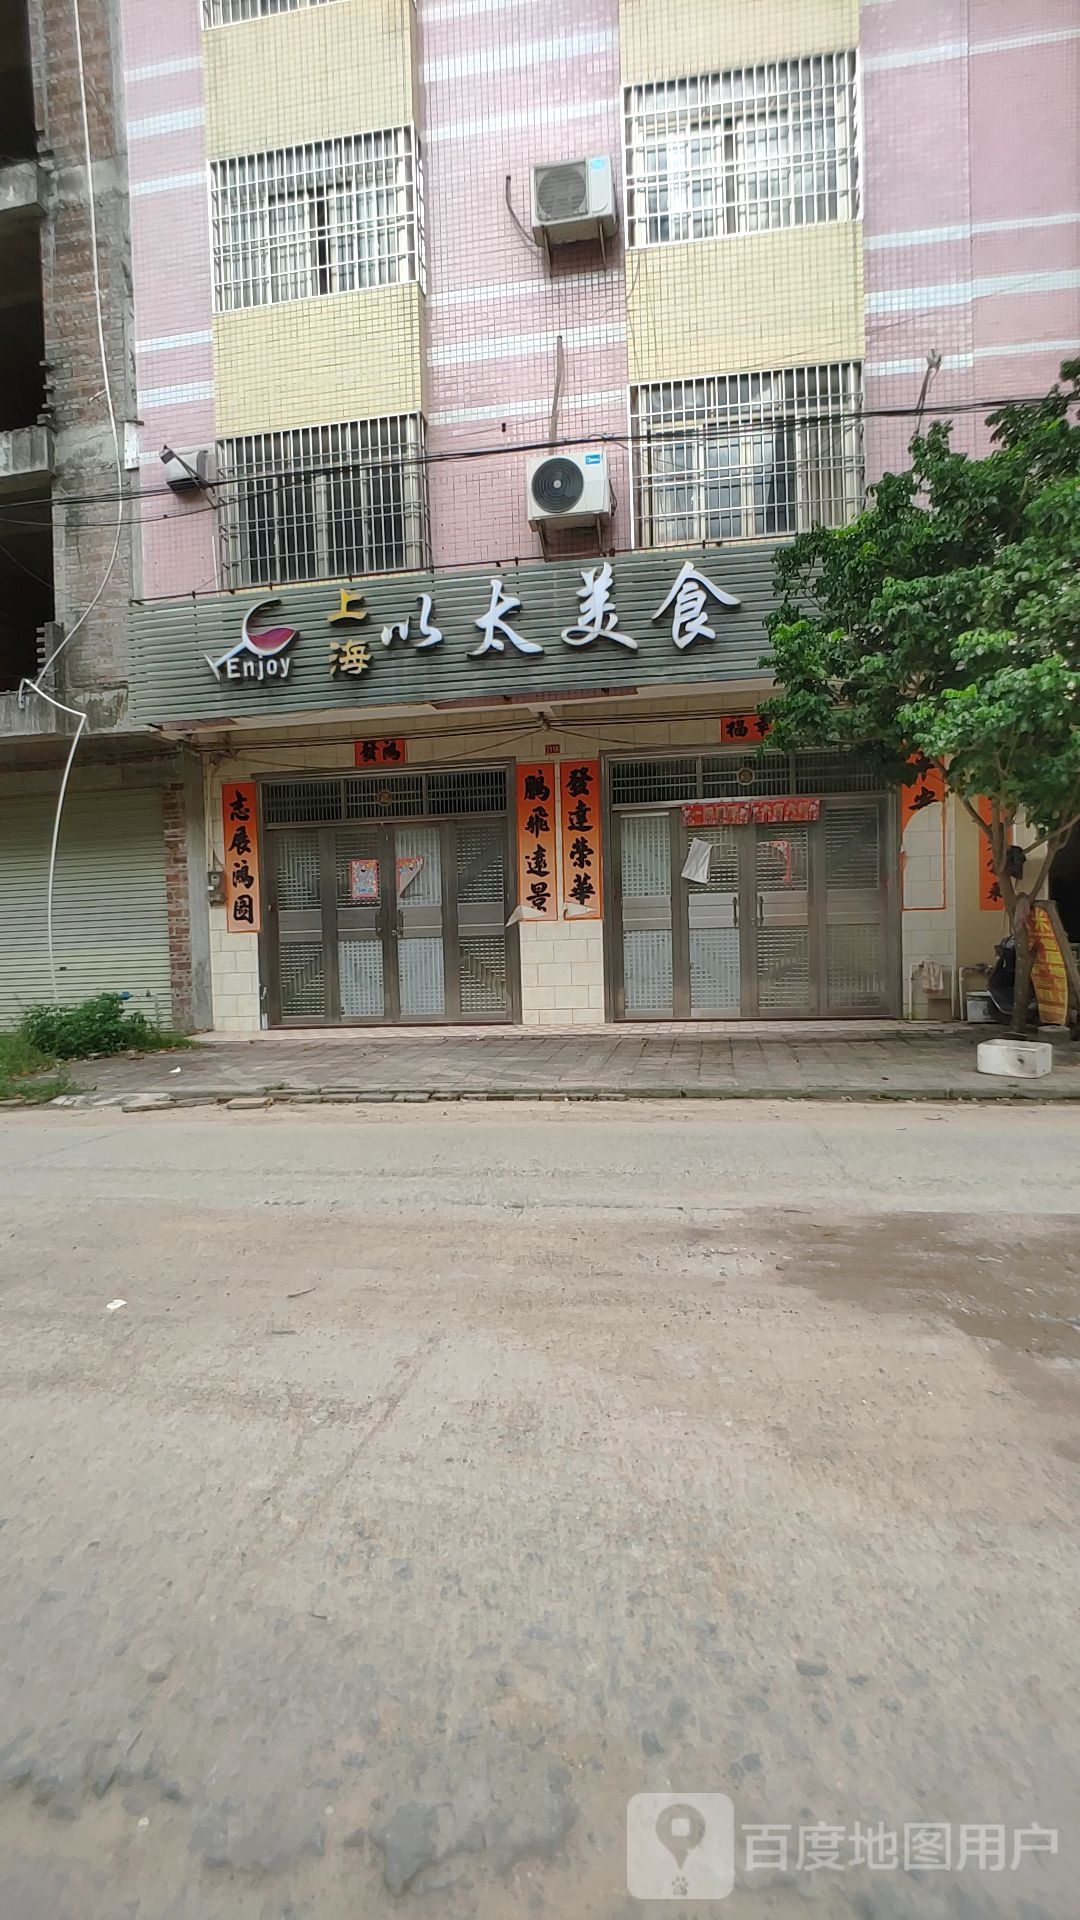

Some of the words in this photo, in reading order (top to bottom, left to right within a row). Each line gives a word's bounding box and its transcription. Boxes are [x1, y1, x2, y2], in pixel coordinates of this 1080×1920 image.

[327, 588, 373, 676] 上海
[381, 560, 741, 657] 以太美食
[227, 654, 291, 681] Enjoy
